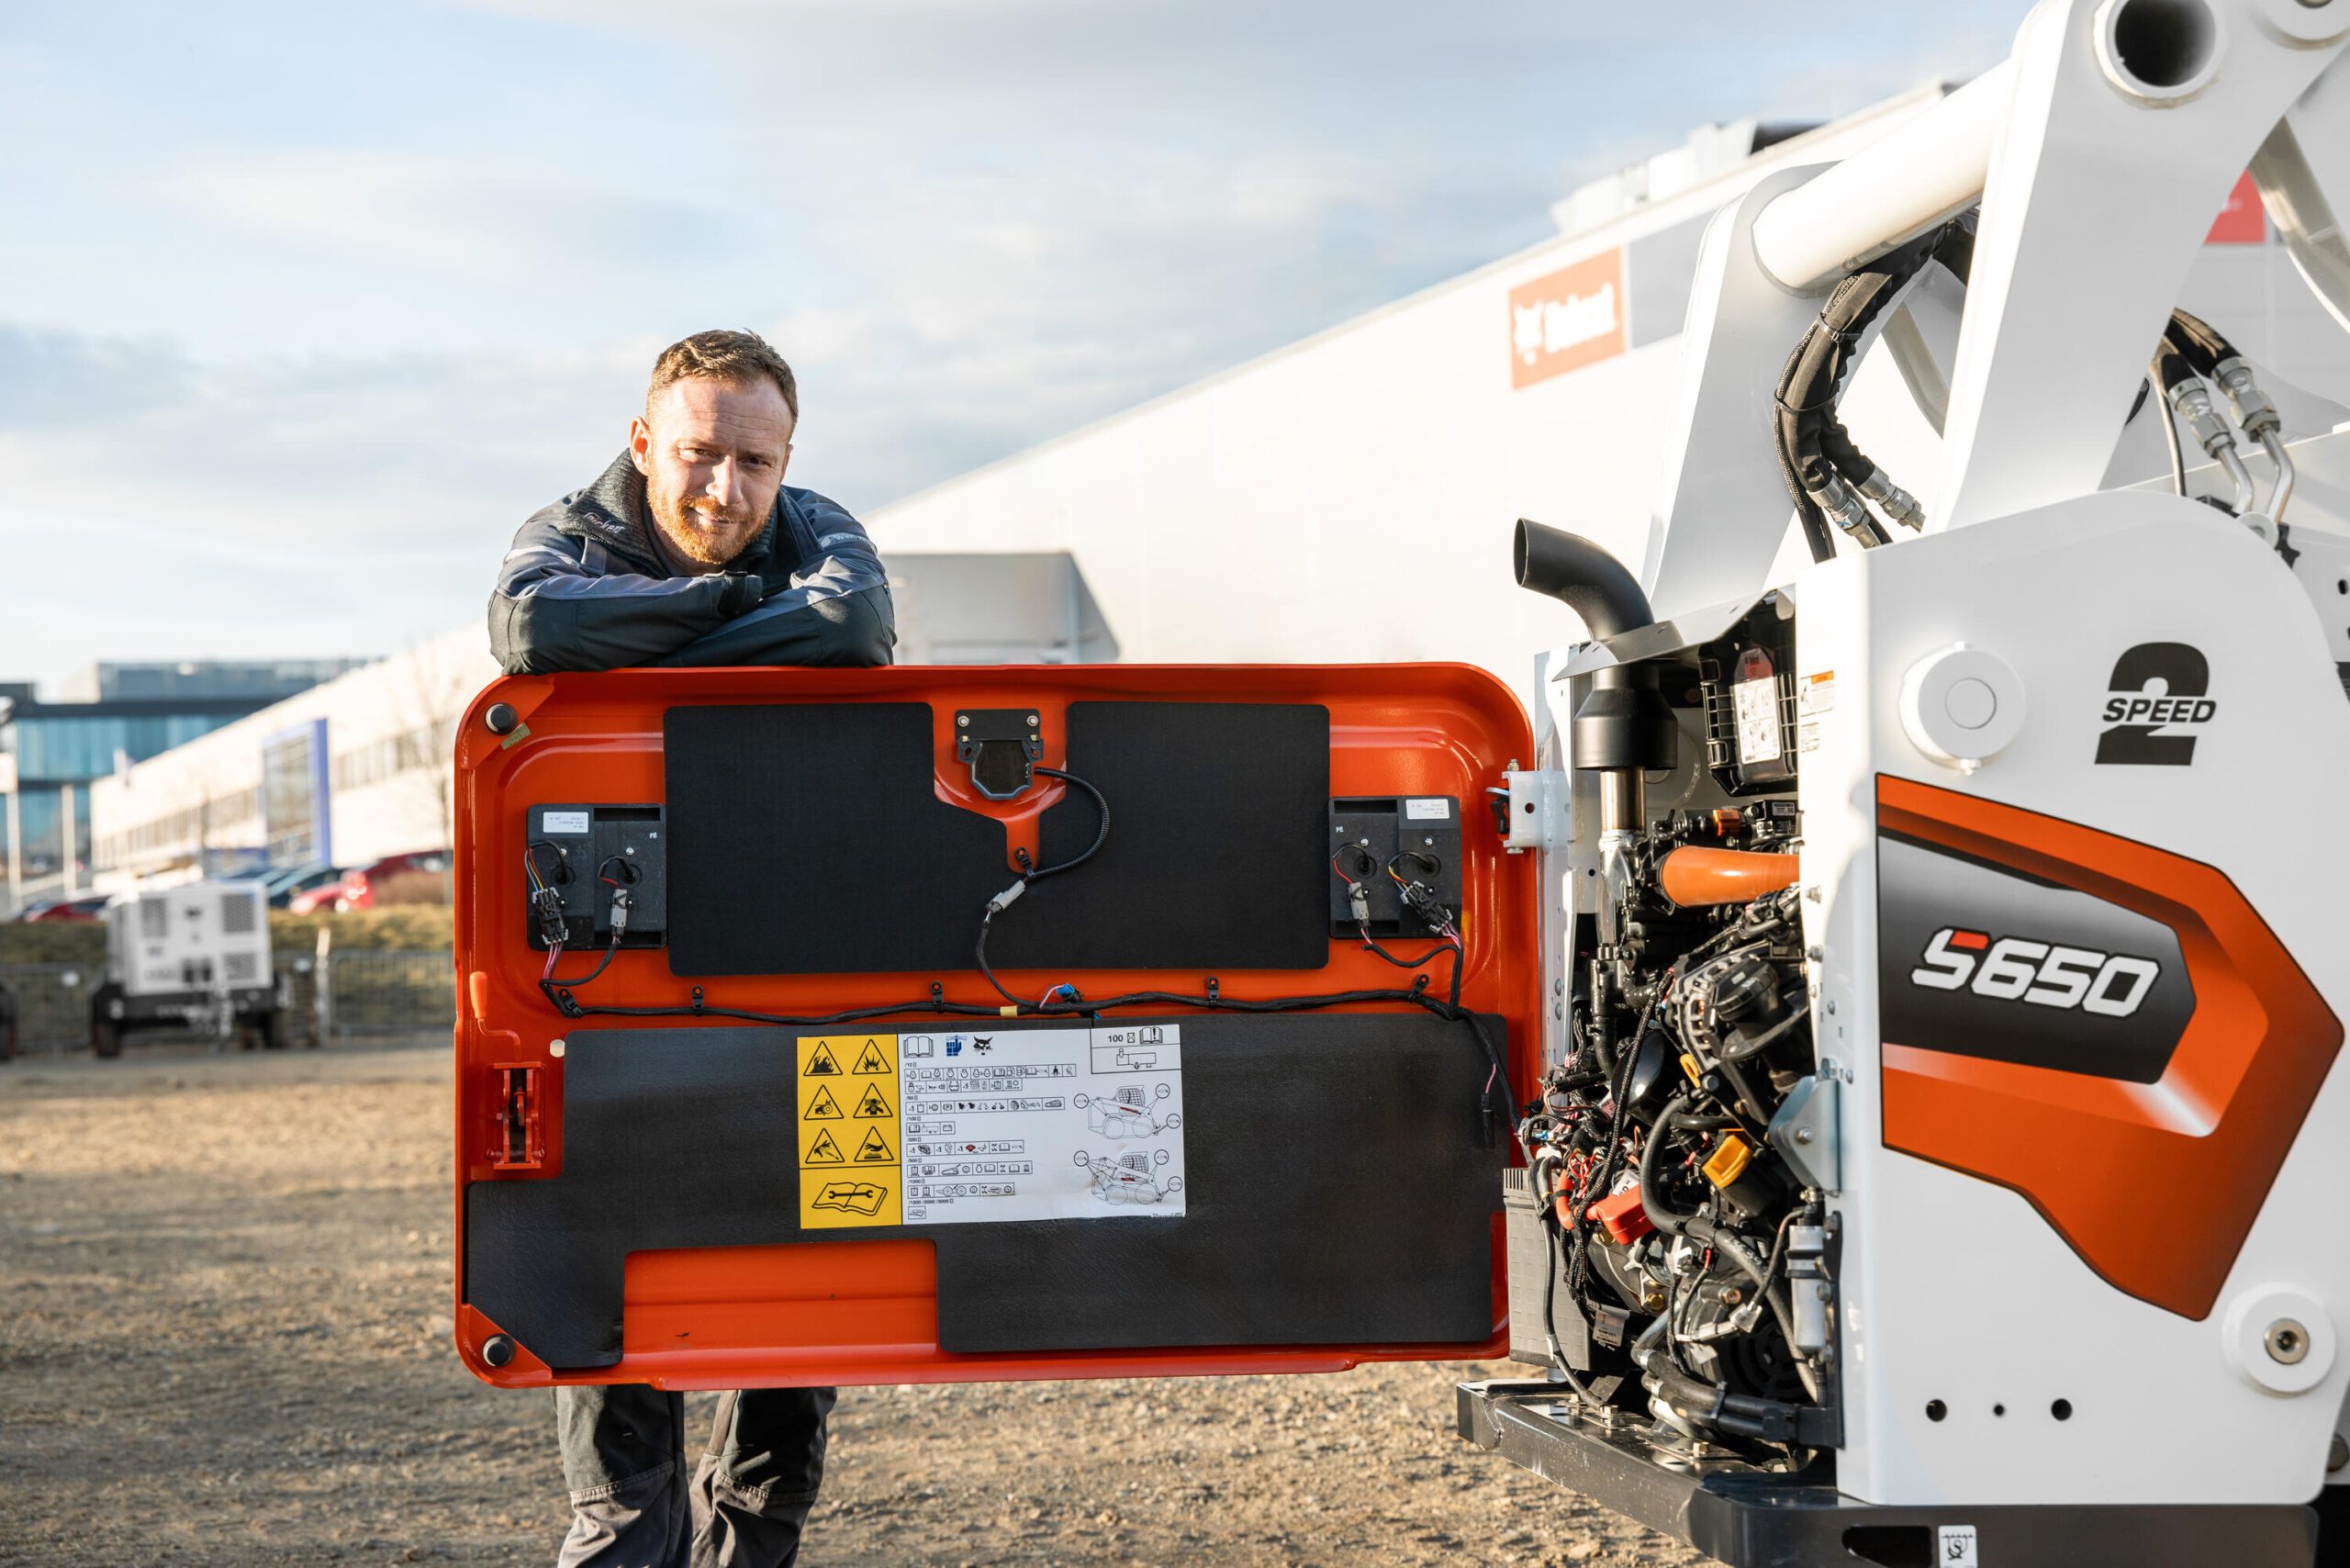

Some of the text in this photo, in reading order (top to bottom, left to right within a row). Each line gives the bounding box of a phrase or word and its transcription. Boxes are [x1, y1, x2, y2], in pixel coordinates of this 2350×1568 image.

[2095, 642, 2210, 766] 2
[2102, 698, 2217, 722] SPEED
[1911, 928, 2159, 1017] S650
[1107, 1034, 1124, 1043] 100
